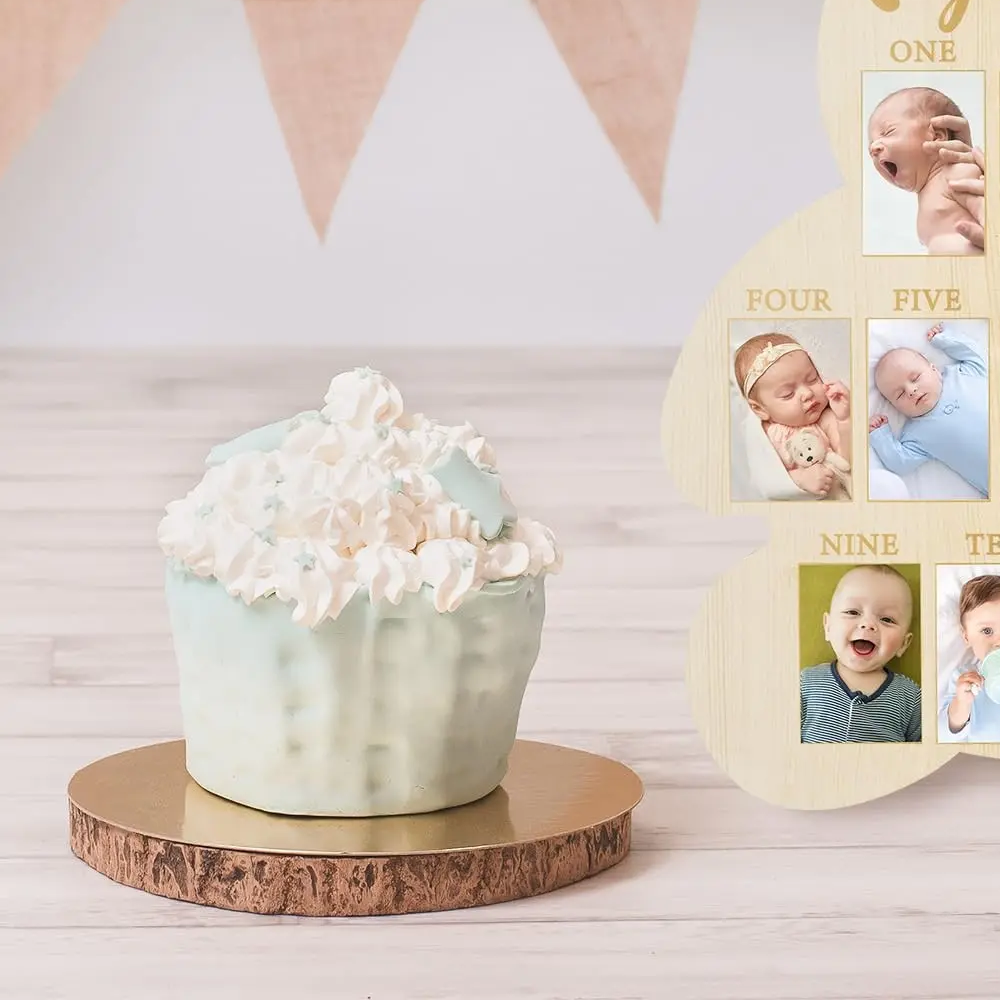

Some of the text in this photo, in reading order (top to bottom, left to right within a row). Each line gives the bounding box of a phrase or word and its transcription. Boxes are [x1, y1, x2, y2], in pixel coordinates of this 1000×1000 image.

[890, 40, 957, 62] ONE
[746, 288, 831, 311] FOUR
[893, 288, 961, 311] FIVE
[820, 533, 899, 556] NINE
